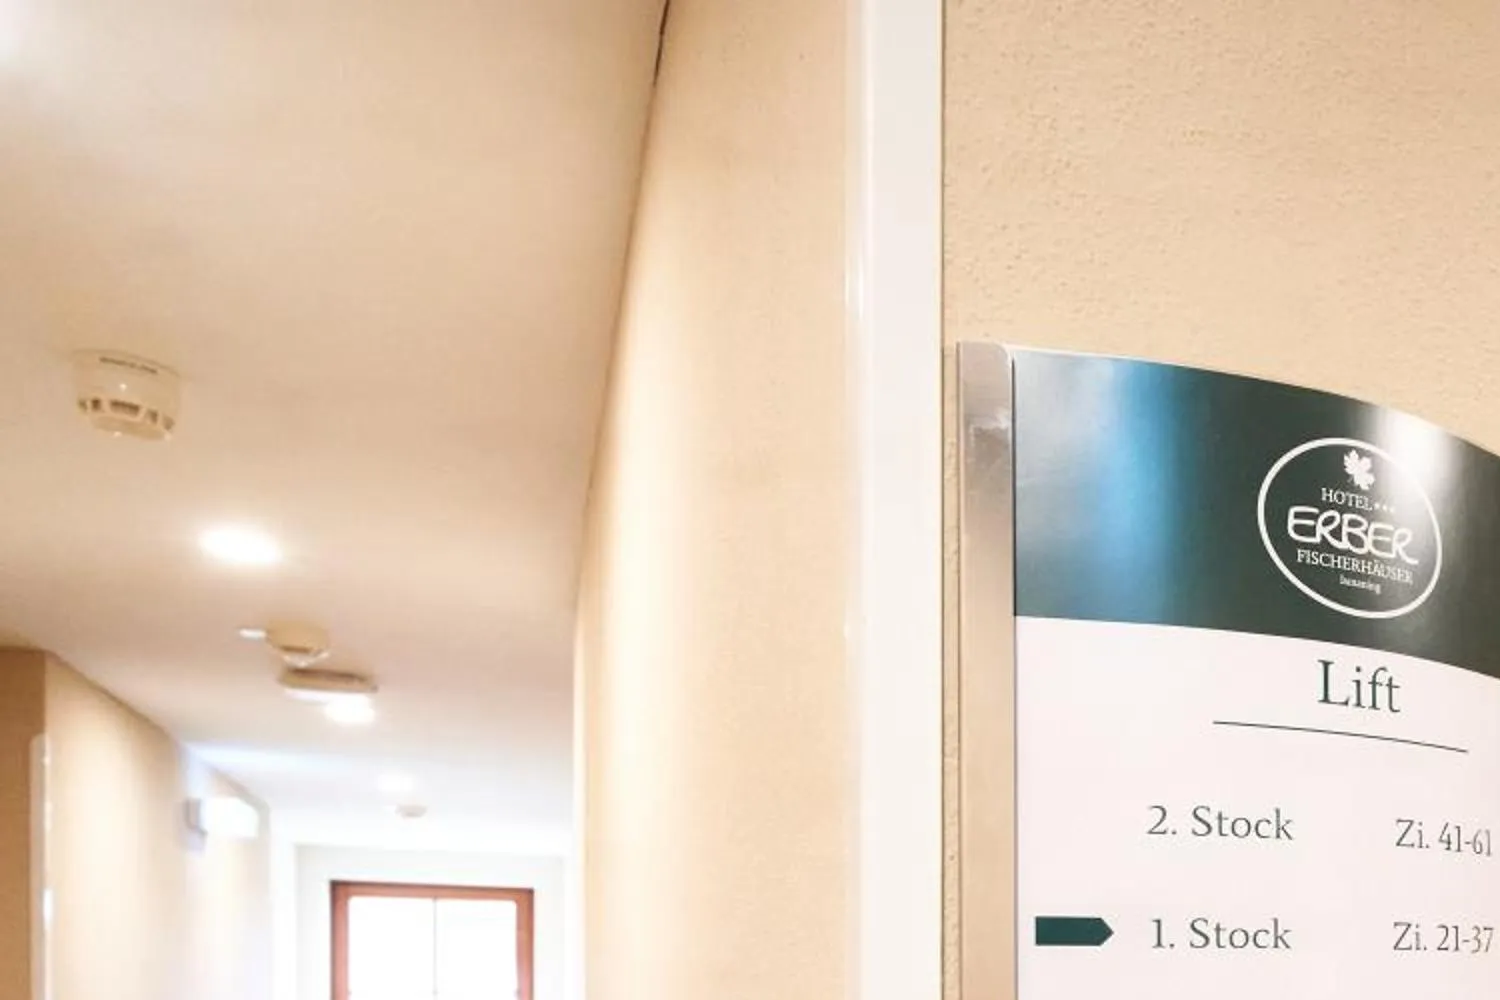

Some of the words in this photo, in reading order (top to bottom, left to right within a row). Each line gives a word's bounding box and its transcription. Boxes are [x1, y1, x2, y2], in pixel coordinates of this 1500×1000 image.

[1321, 488, 1372, 511] HOTEL
[1287, 505, 1418, 565] ERBER
[1318, 659, 1401, 713] Lift
[1147, 805, 1178, 836] 2.
[1191, 805, 1294, 841] Stock
[1395, 819, 1430, 849] Zi.
[1438, 822, 1492, 858] 41-61
[1152, 918, 1175, 949] 1.
[1189, 917, 1291, 950] Stock
[1393, 921, 1428, 951] Zi.
[1436, 924, 1494, 954] 21-37
